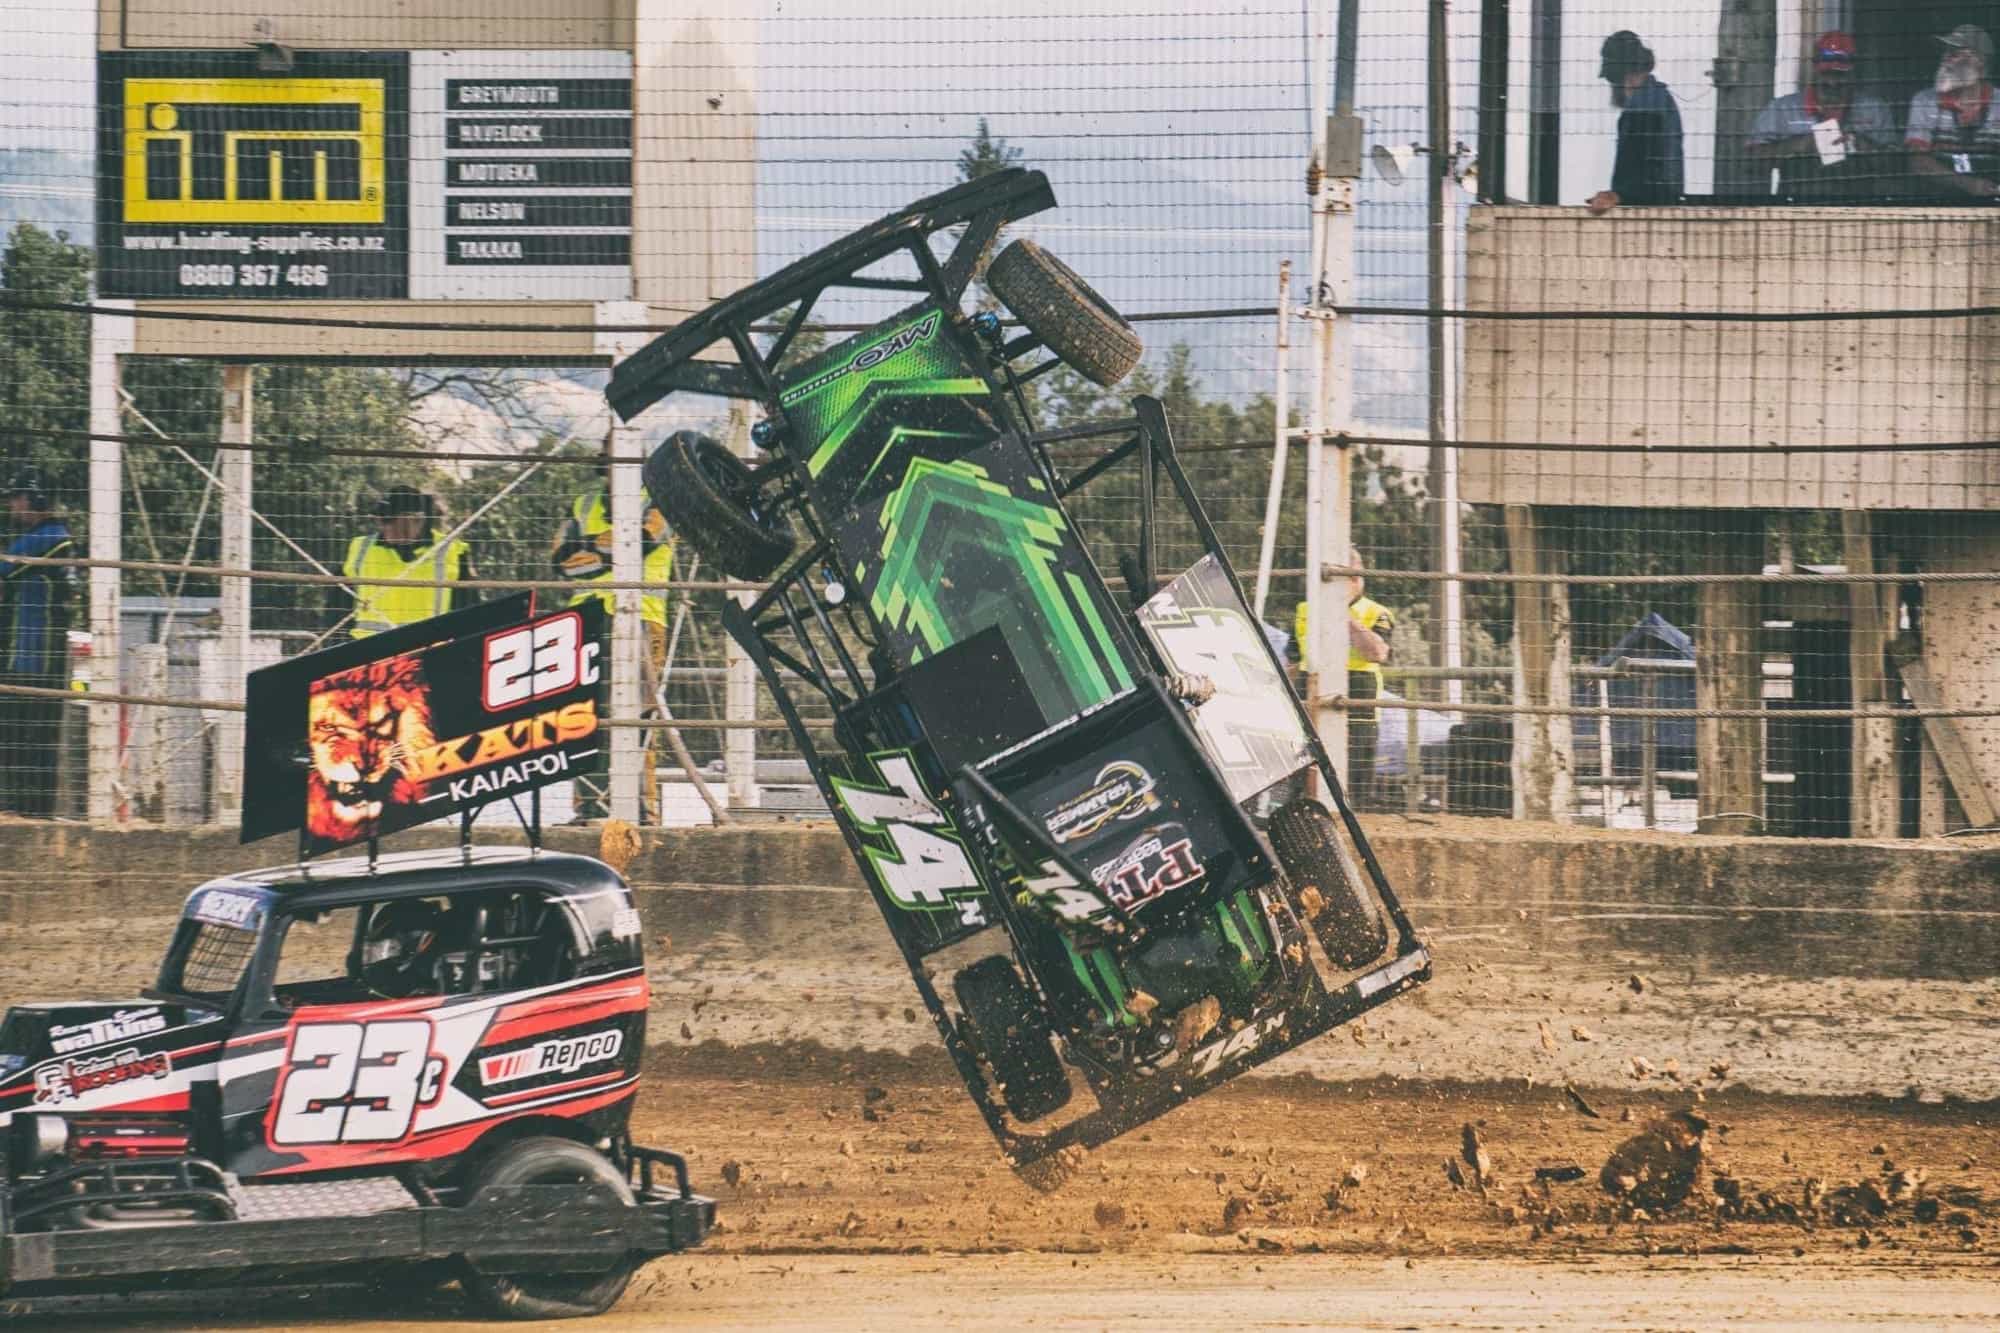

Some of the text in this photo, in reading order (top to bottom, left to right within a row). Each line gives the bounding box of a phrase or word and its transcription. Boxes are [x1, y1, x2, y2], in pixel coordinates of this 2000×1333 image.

[459, 86, 559, 104] GREYMOUTH
[459, 125, 544, 142] HAVELOCK
[459, 164, 539, 181] MOTUEKA
[459, 203, 526, 220] NELSON
[123, 231, 385, 254] www.building-supplies.co.nz
[458, 242, 523, 259] TAKAKA
[179, 264, 234, 286] 0800
[240, 264, 280, 286] 367
[417, 699, 598, 783] KATS
[449, 753, 568, 802] KAIAPOI
[539, 1032, 618, 1070] Repco
